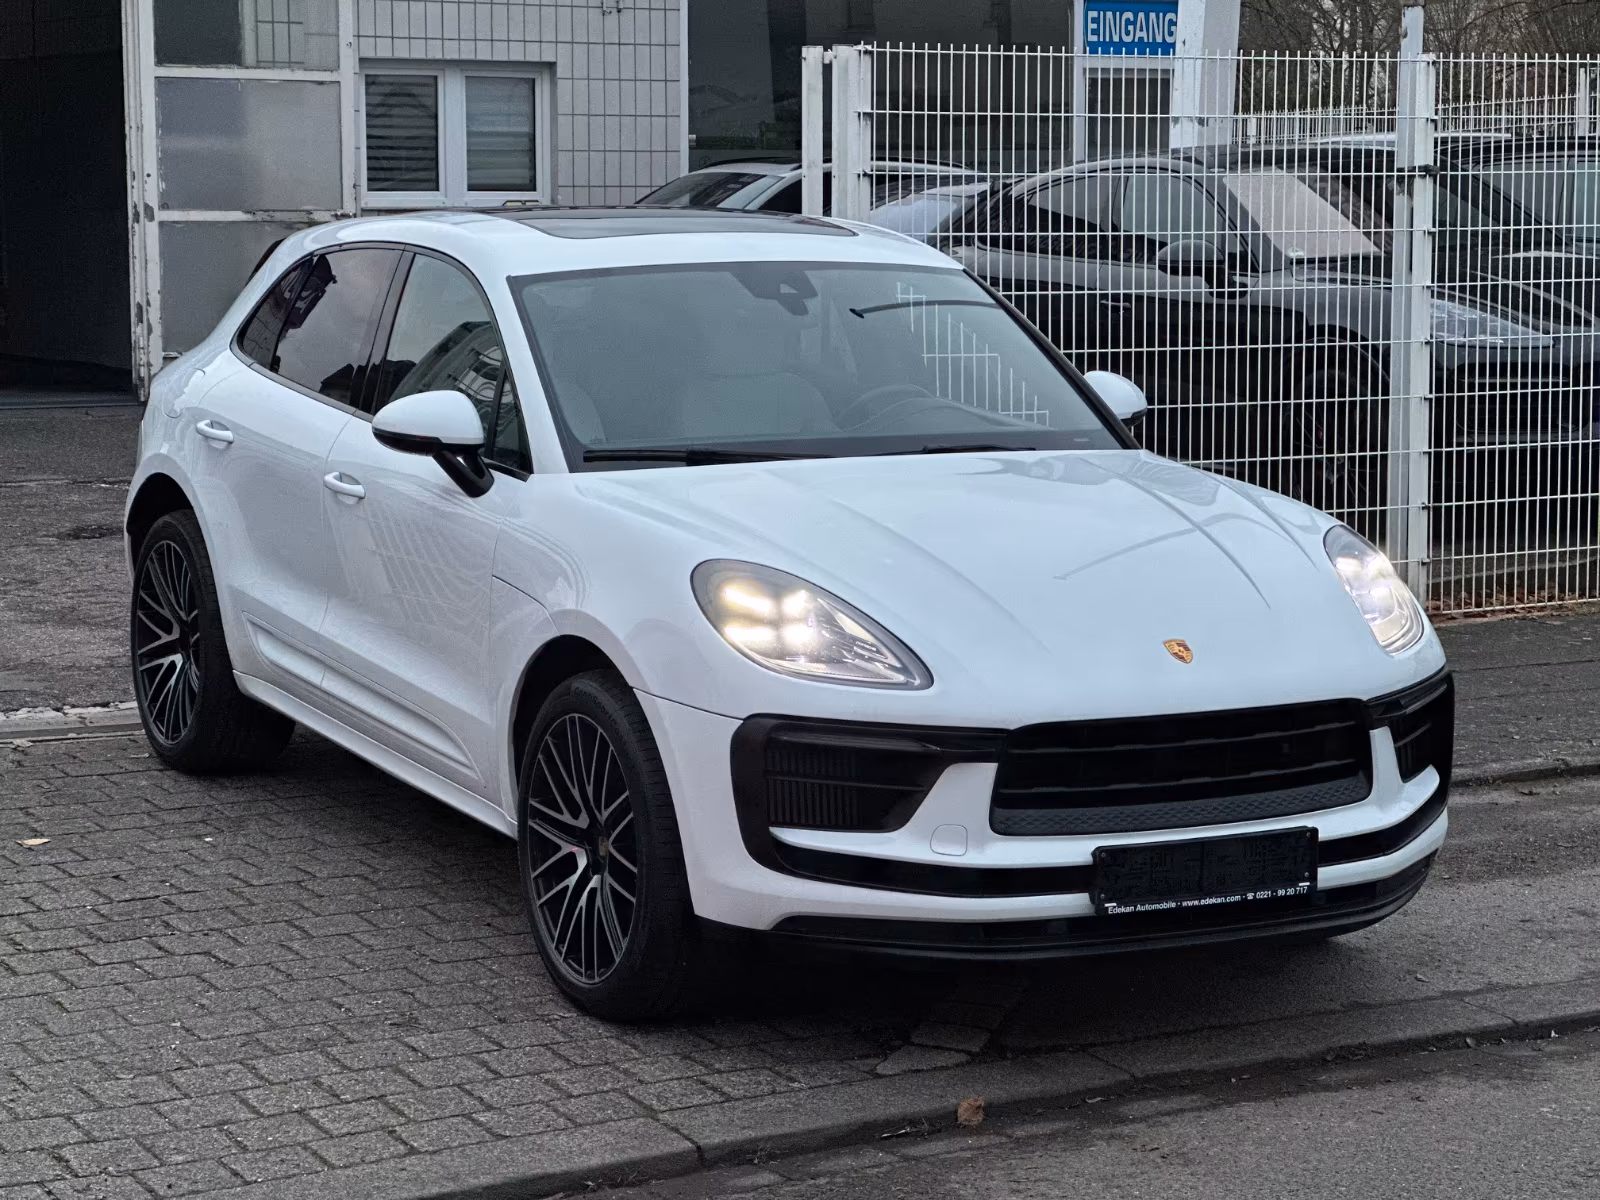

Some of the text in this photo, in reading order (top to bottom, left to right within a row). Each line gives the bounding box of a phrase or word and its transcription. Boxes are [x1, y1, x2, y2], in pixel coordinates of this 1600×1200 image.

[1087, 10, 1178, 44] EINGANG
[1108, 905, 1134, 914] Edekan
[1135, 900, 1176, 911] Automobile
[1181, 894, 1241, 907] www.edekan.com
[1256, 891, 1271, 899] 0221
[1277, 889, 1286, 897] 99
[1286, 887, 1295, 895] 20
[1296, 886, 1308, 894] 717
